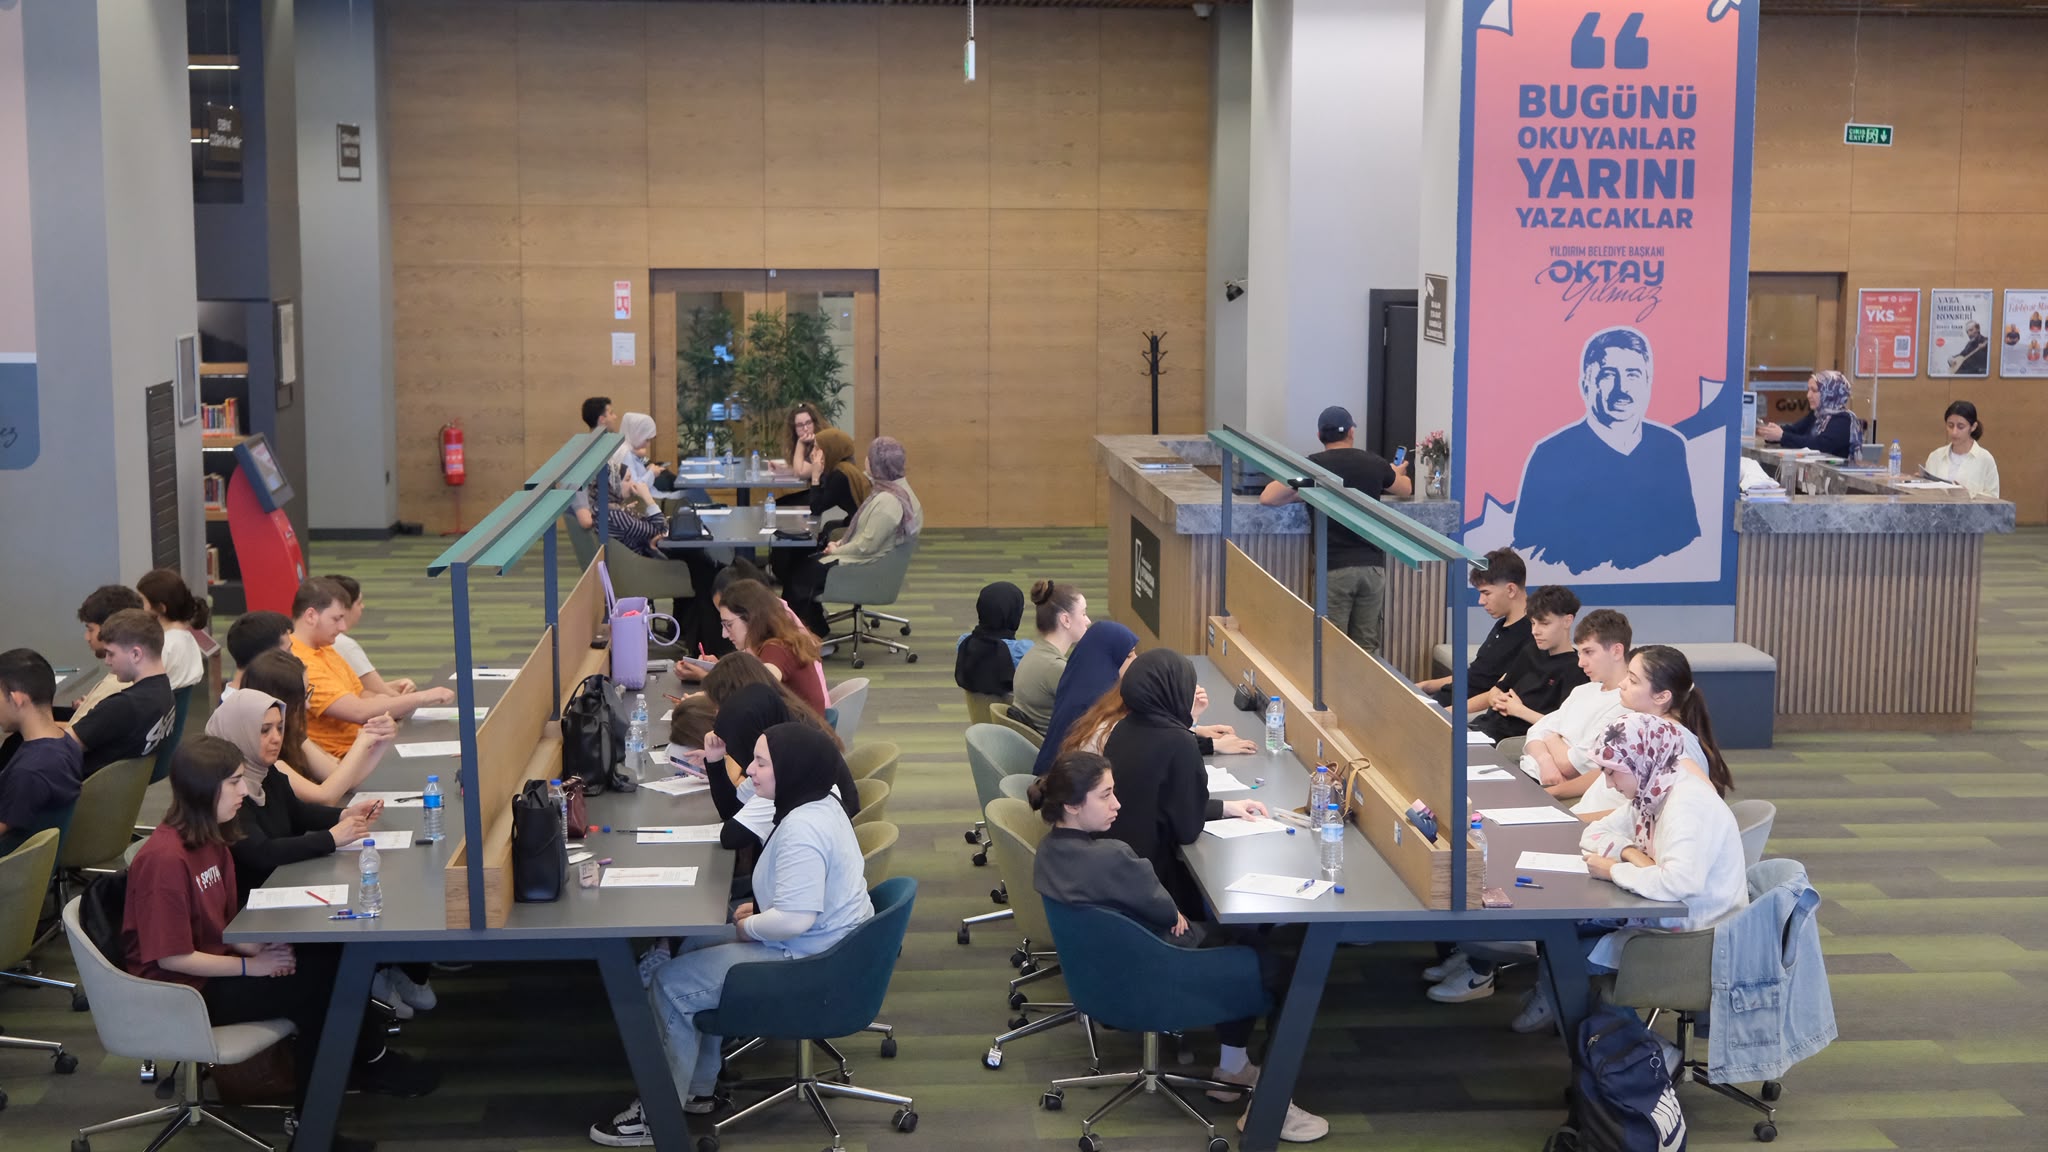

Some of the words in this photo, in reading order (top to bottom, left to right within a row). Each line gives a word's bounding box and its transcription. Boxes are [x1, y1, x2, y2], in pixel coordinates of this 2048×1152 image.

[1519, 84, 1697, 119] BUGÜNÜ
[1518, 126, 1696, 150] OKUYANLAR
[1516, 158, 1696, 199] YARINI
[1515, 207, 1694, 229] YAZACAKLAR
[1549, 246, 1586, 257] YILDIRIM
[1629, 246, 1665, 258] BAŞKANI
[1549, 260, 1665, 286] OKTAY
[1866, 309, 1895, 322] YKS
